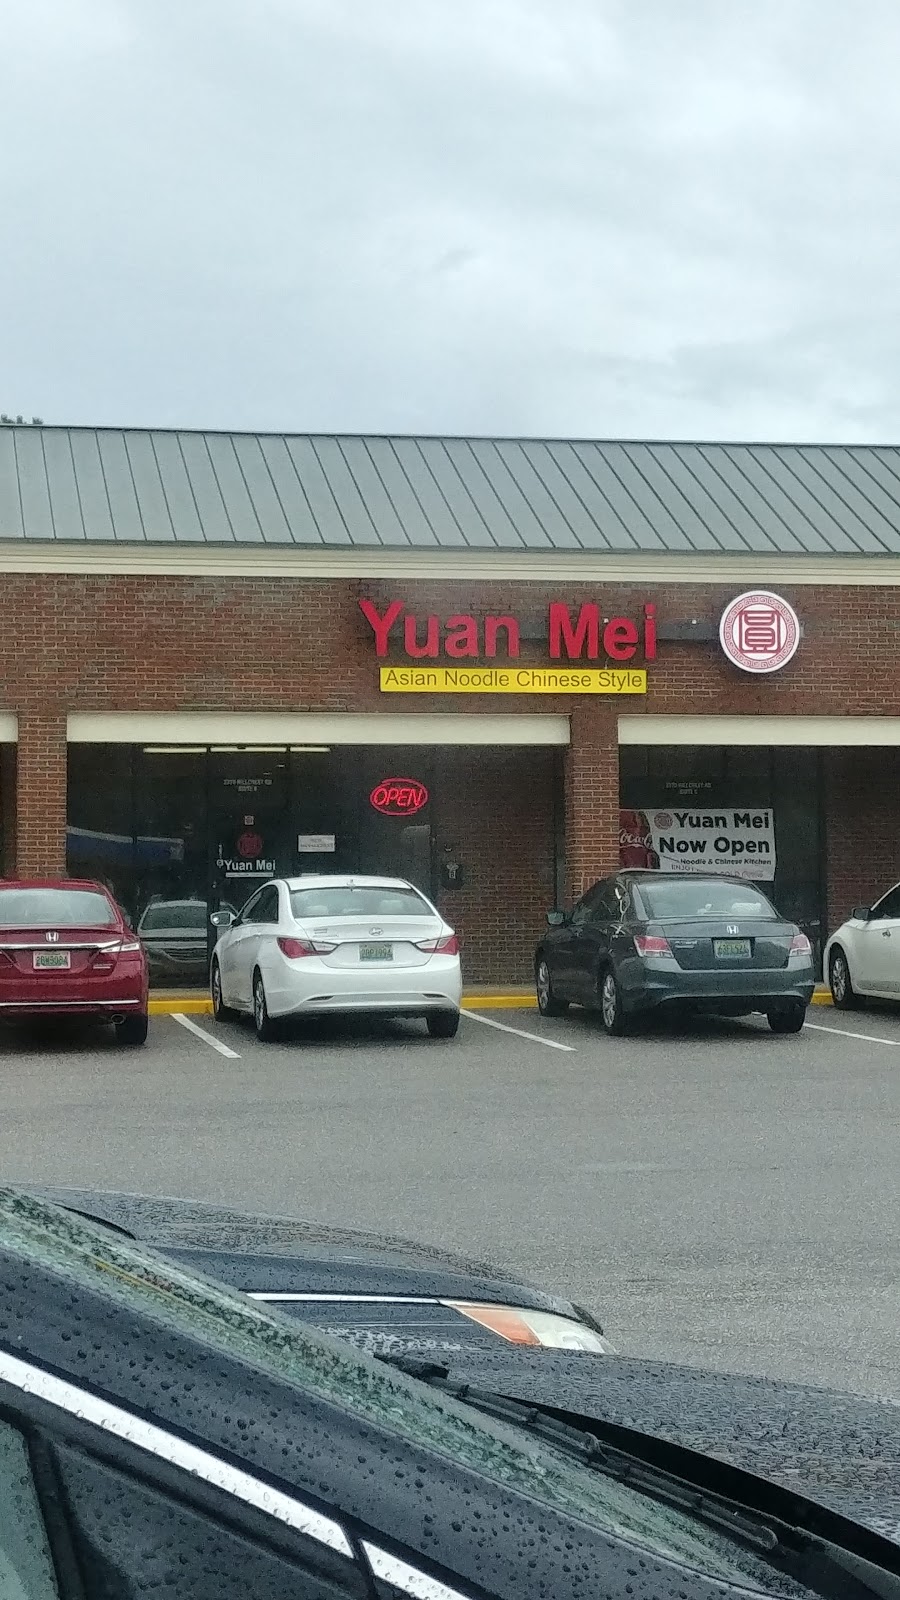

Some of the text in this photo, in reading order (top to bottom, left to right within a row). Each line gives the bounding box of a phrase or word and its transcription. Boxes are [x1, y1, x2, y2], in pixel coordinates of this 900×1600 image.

[358, 599, 657, 660] Yuan Mei
[385, 669, 643, 691] Asian Noodle Chinese Style
[373, 787, 423, 807] OPEN
[674, 812, 770, 829] Yuan Mei
[659, 836, 771, 856] Now Open
[224, 859, 276, 871] Yuan Mei
[714, 858, 743, 866] Chinese
[743, 858, 772, 866] Kitchen
